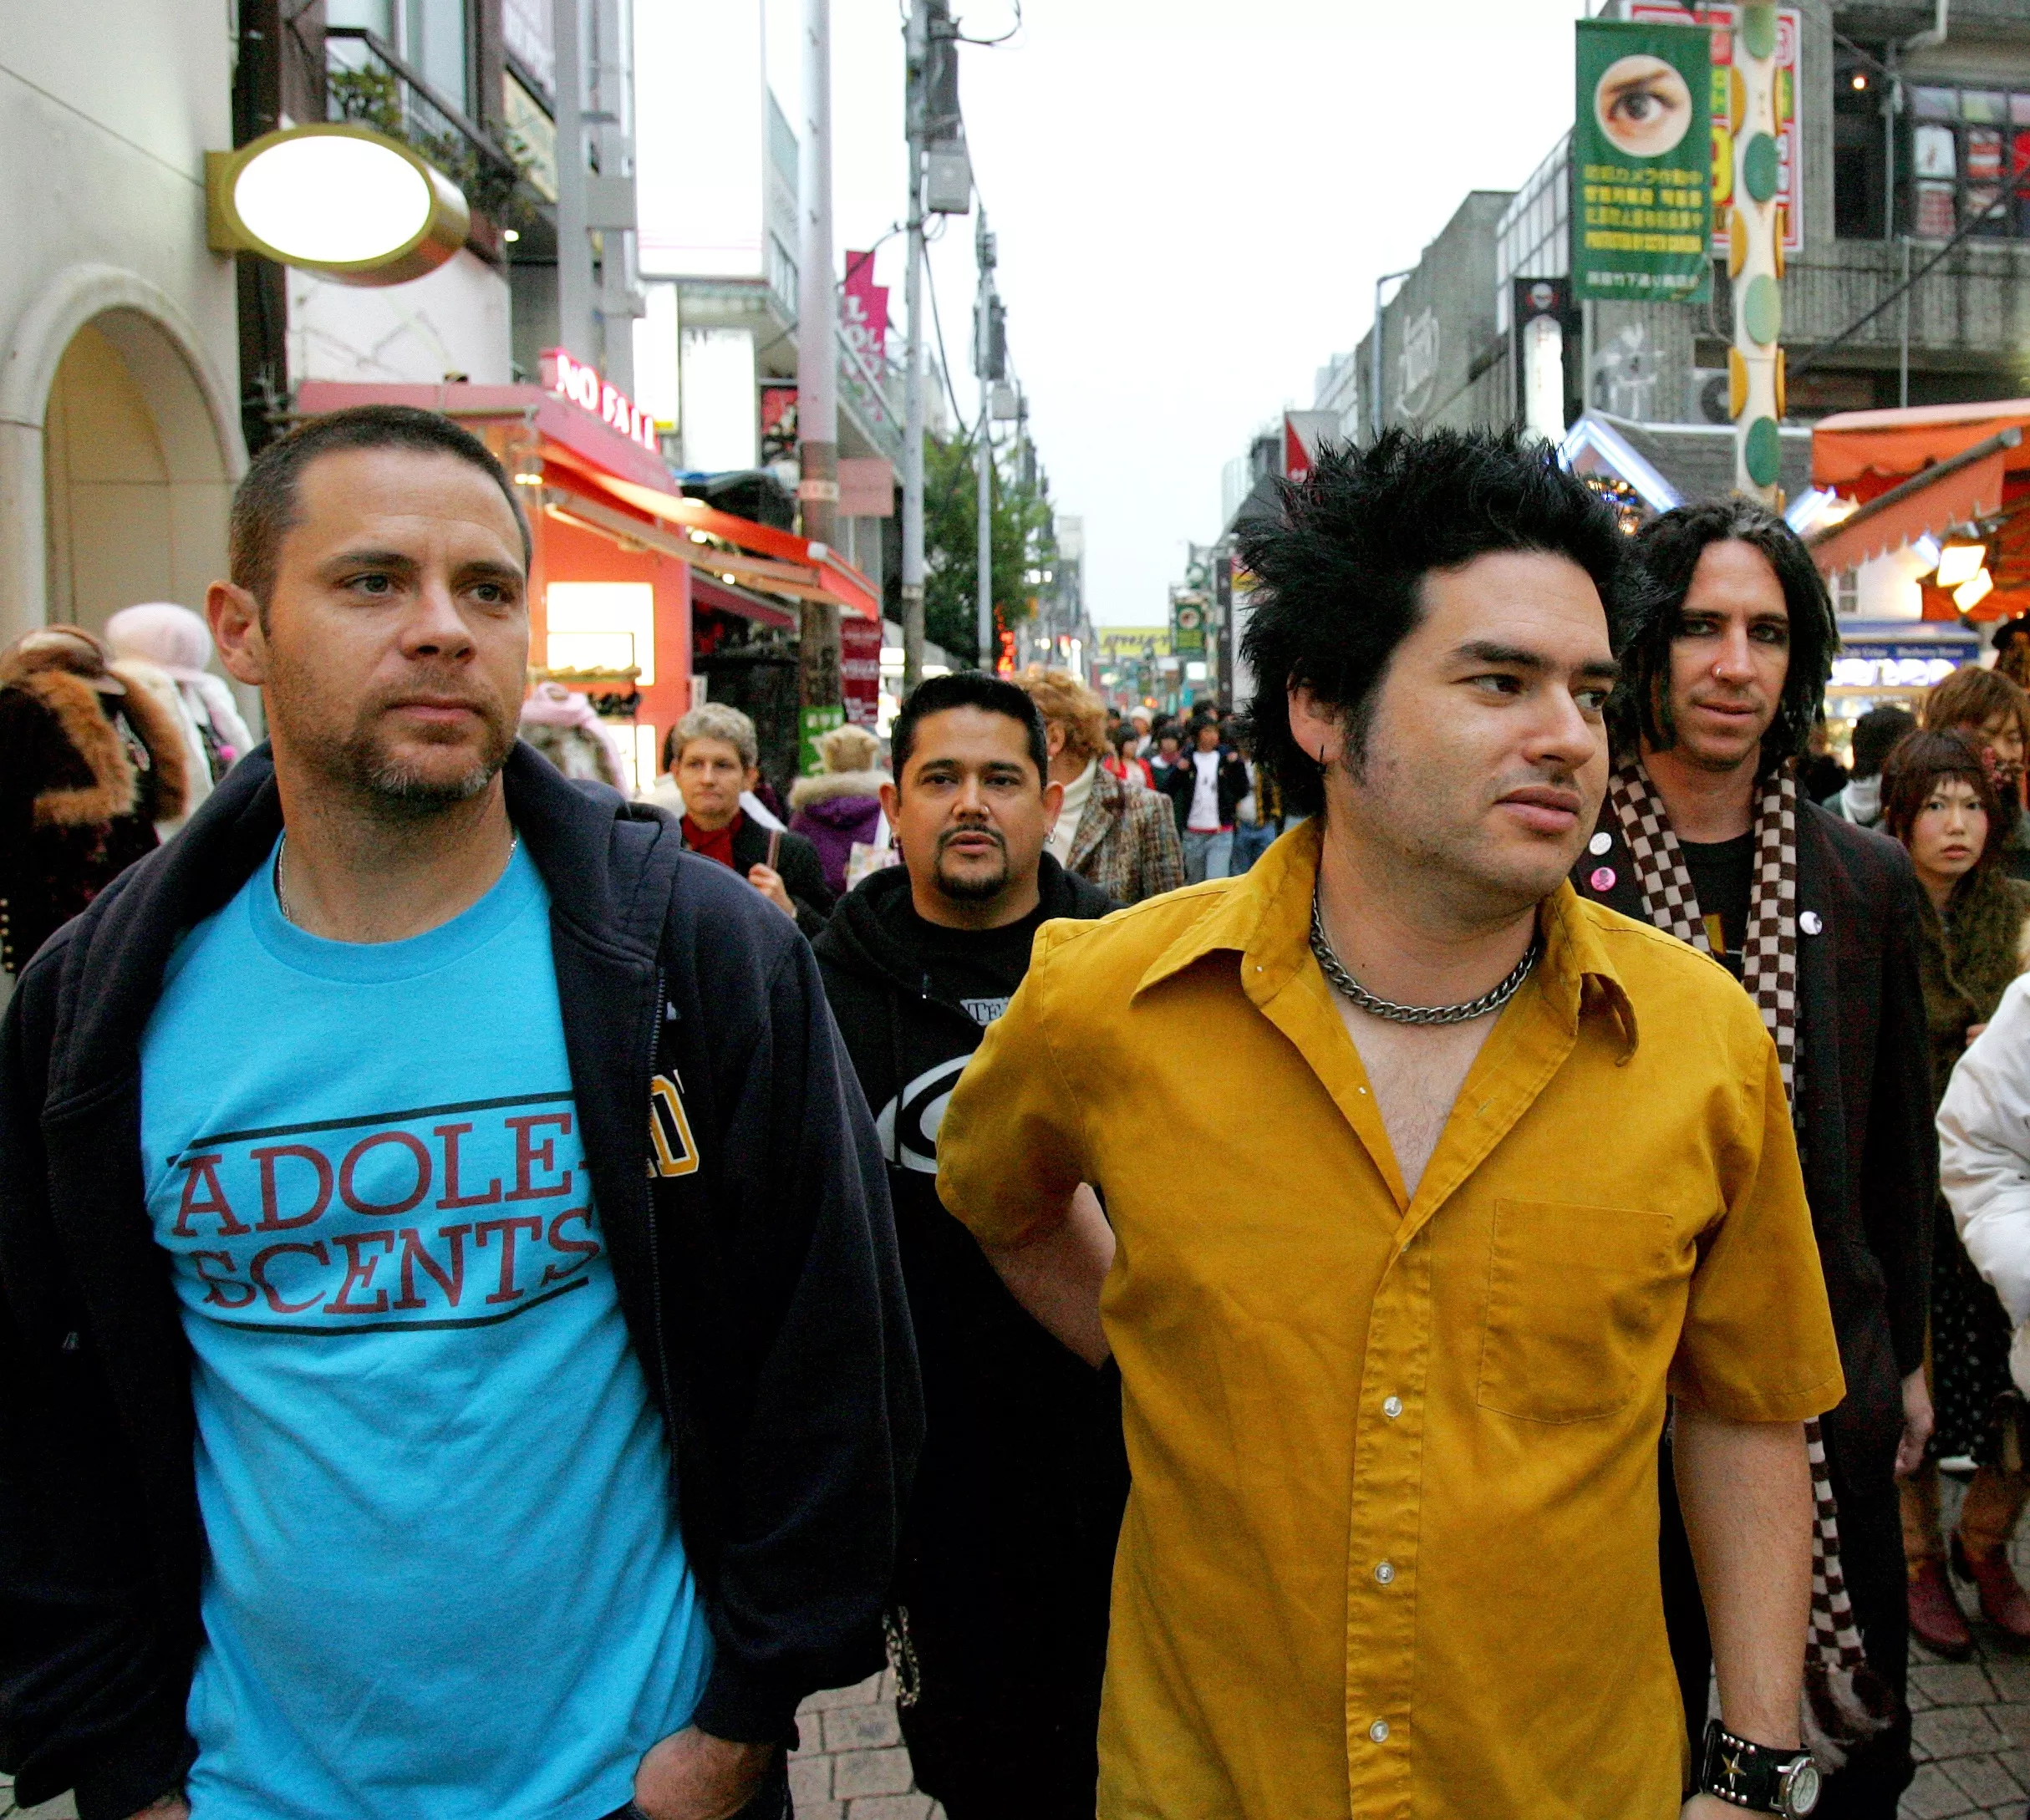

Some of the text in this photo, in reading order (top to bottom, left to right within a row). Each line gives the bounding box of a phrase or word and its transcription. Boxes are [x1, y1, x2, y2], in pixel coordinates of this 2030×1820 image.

[556, 354, 599, 410] NO
[967, 1001, 1010, 1022] TE
[189, 1205, 602, 1315] SCENTS
